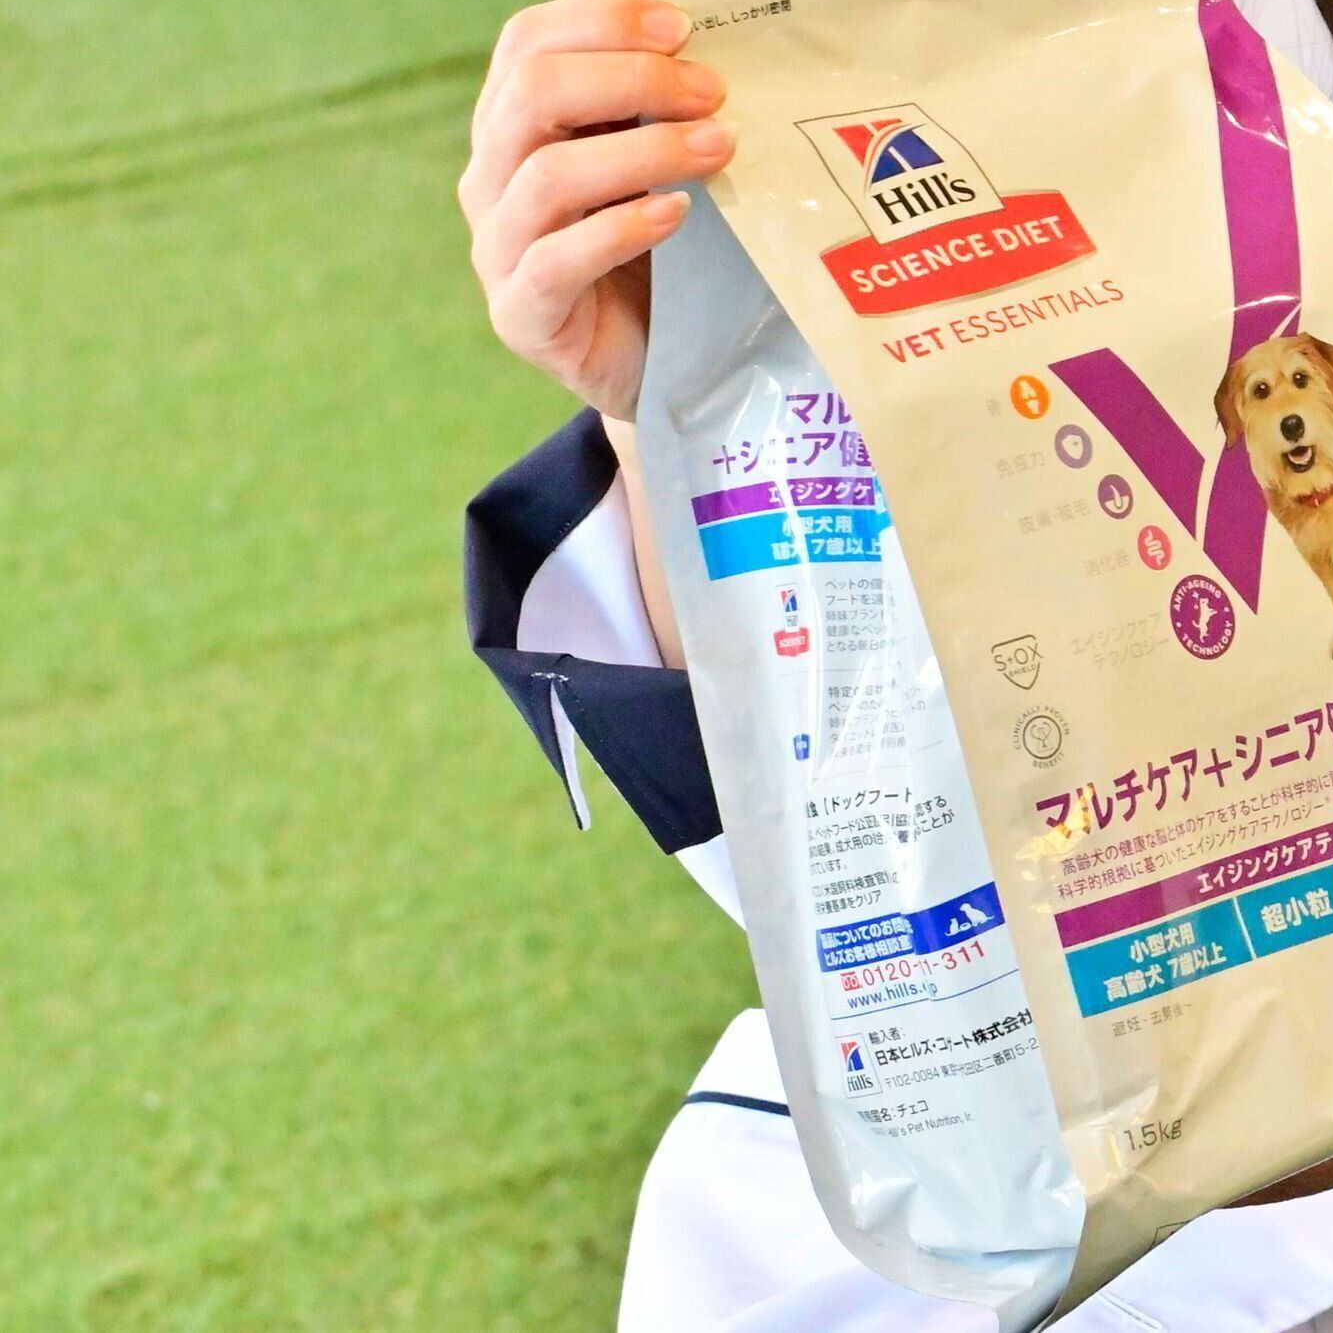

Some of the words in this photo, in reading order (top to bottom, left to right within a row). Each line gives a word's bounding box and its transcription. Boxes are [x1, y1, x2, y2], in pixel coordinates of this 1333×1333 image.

[872, 172, 976, 225] Hill's
[850, 233, 993, 293] SCIENCE
[992, 215, 1065, 252] DIET
[882, 327, 945, 363] VET
[949, 279, 1124, 344] ESSENTIALS
[1103, 965, 1165, 1002] 高齢犬
[1167, 941, 1228, 979] 7歳以上
[1129, 922, 1196, 964] 小型犬用
[1123, 1117, 1184, 1152] 1.5kg
